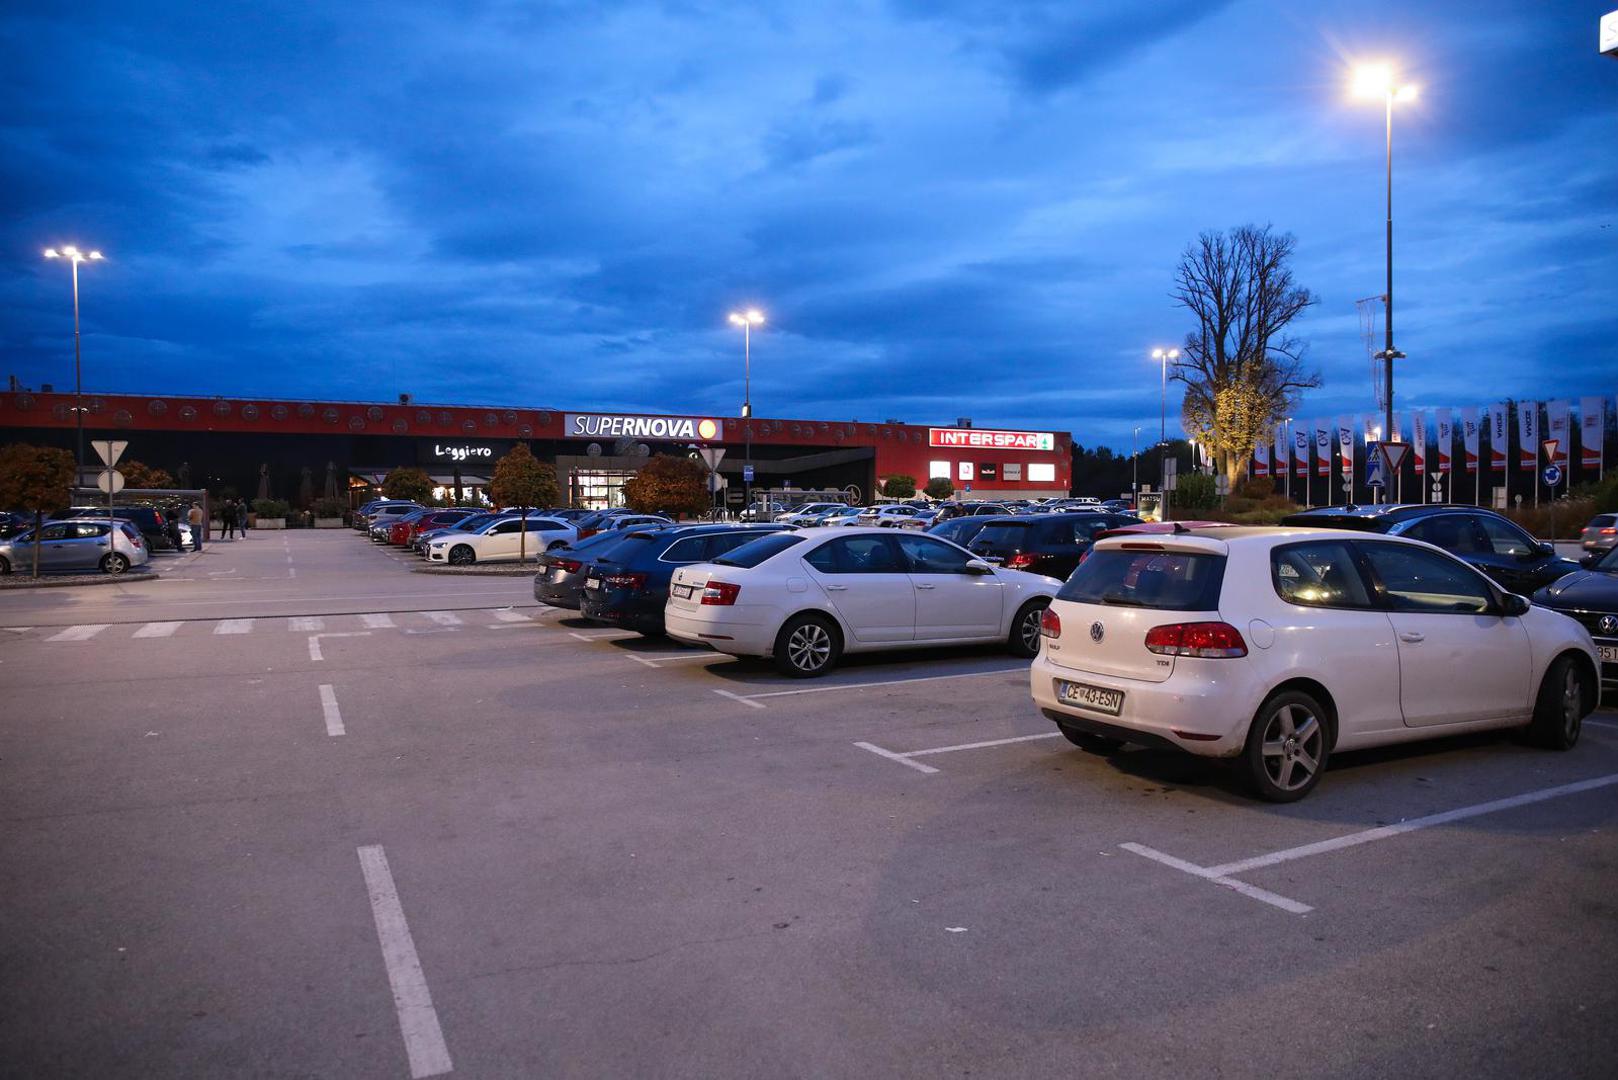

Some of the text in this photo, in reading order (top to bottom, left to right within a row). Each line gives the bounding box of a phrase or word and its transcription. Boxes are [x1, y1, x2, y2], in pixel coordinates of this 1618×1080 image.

[574, 416, 694, 437] SUPERNOVA
[940, 431, 1037, 447] INTERSPAR
[435, 444, 492, 460] Leggiero
[1067, 684, 1080, 700] CE
